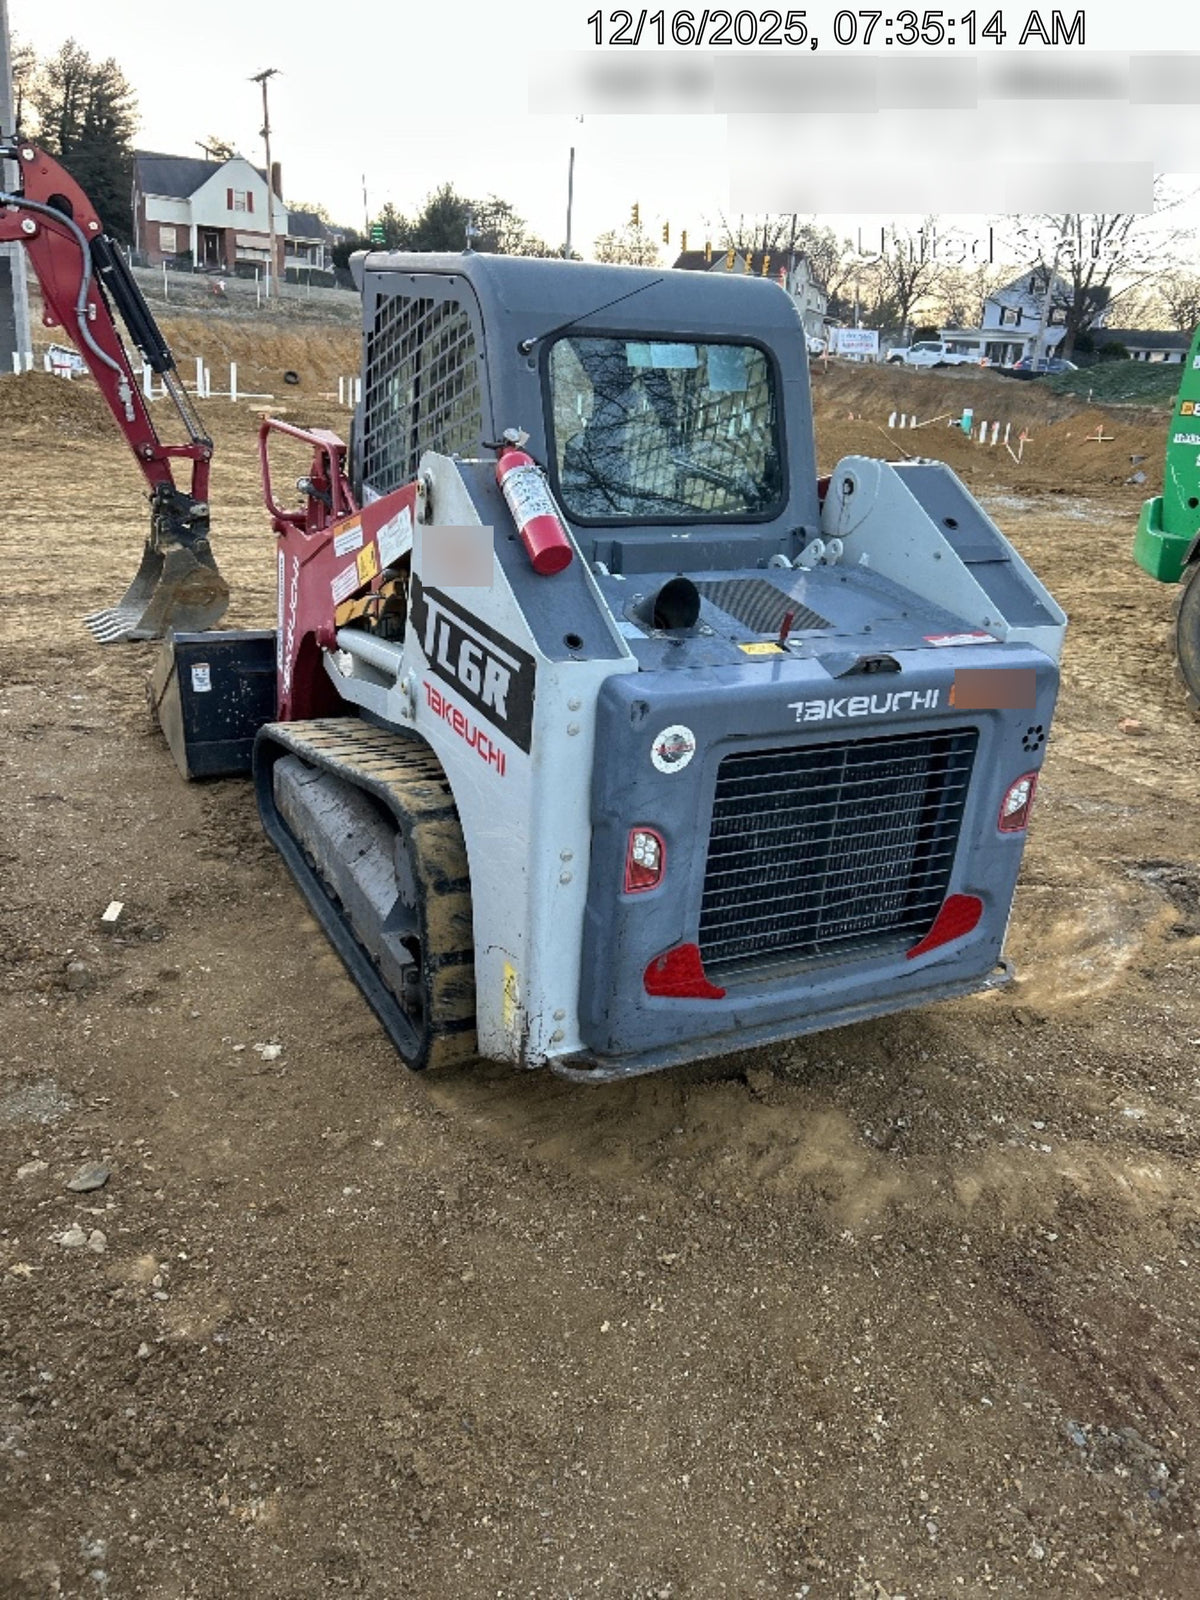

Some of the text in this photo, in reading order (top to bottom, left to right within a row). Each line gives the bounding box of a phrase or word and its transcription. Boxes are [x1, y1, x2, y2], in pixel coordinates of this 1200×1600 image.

[422, 591, 522, 721] TL6R
[423, 680, 506, 777] TAKEUCHI
[787, 689, 940, 723] TAKEUCHI
